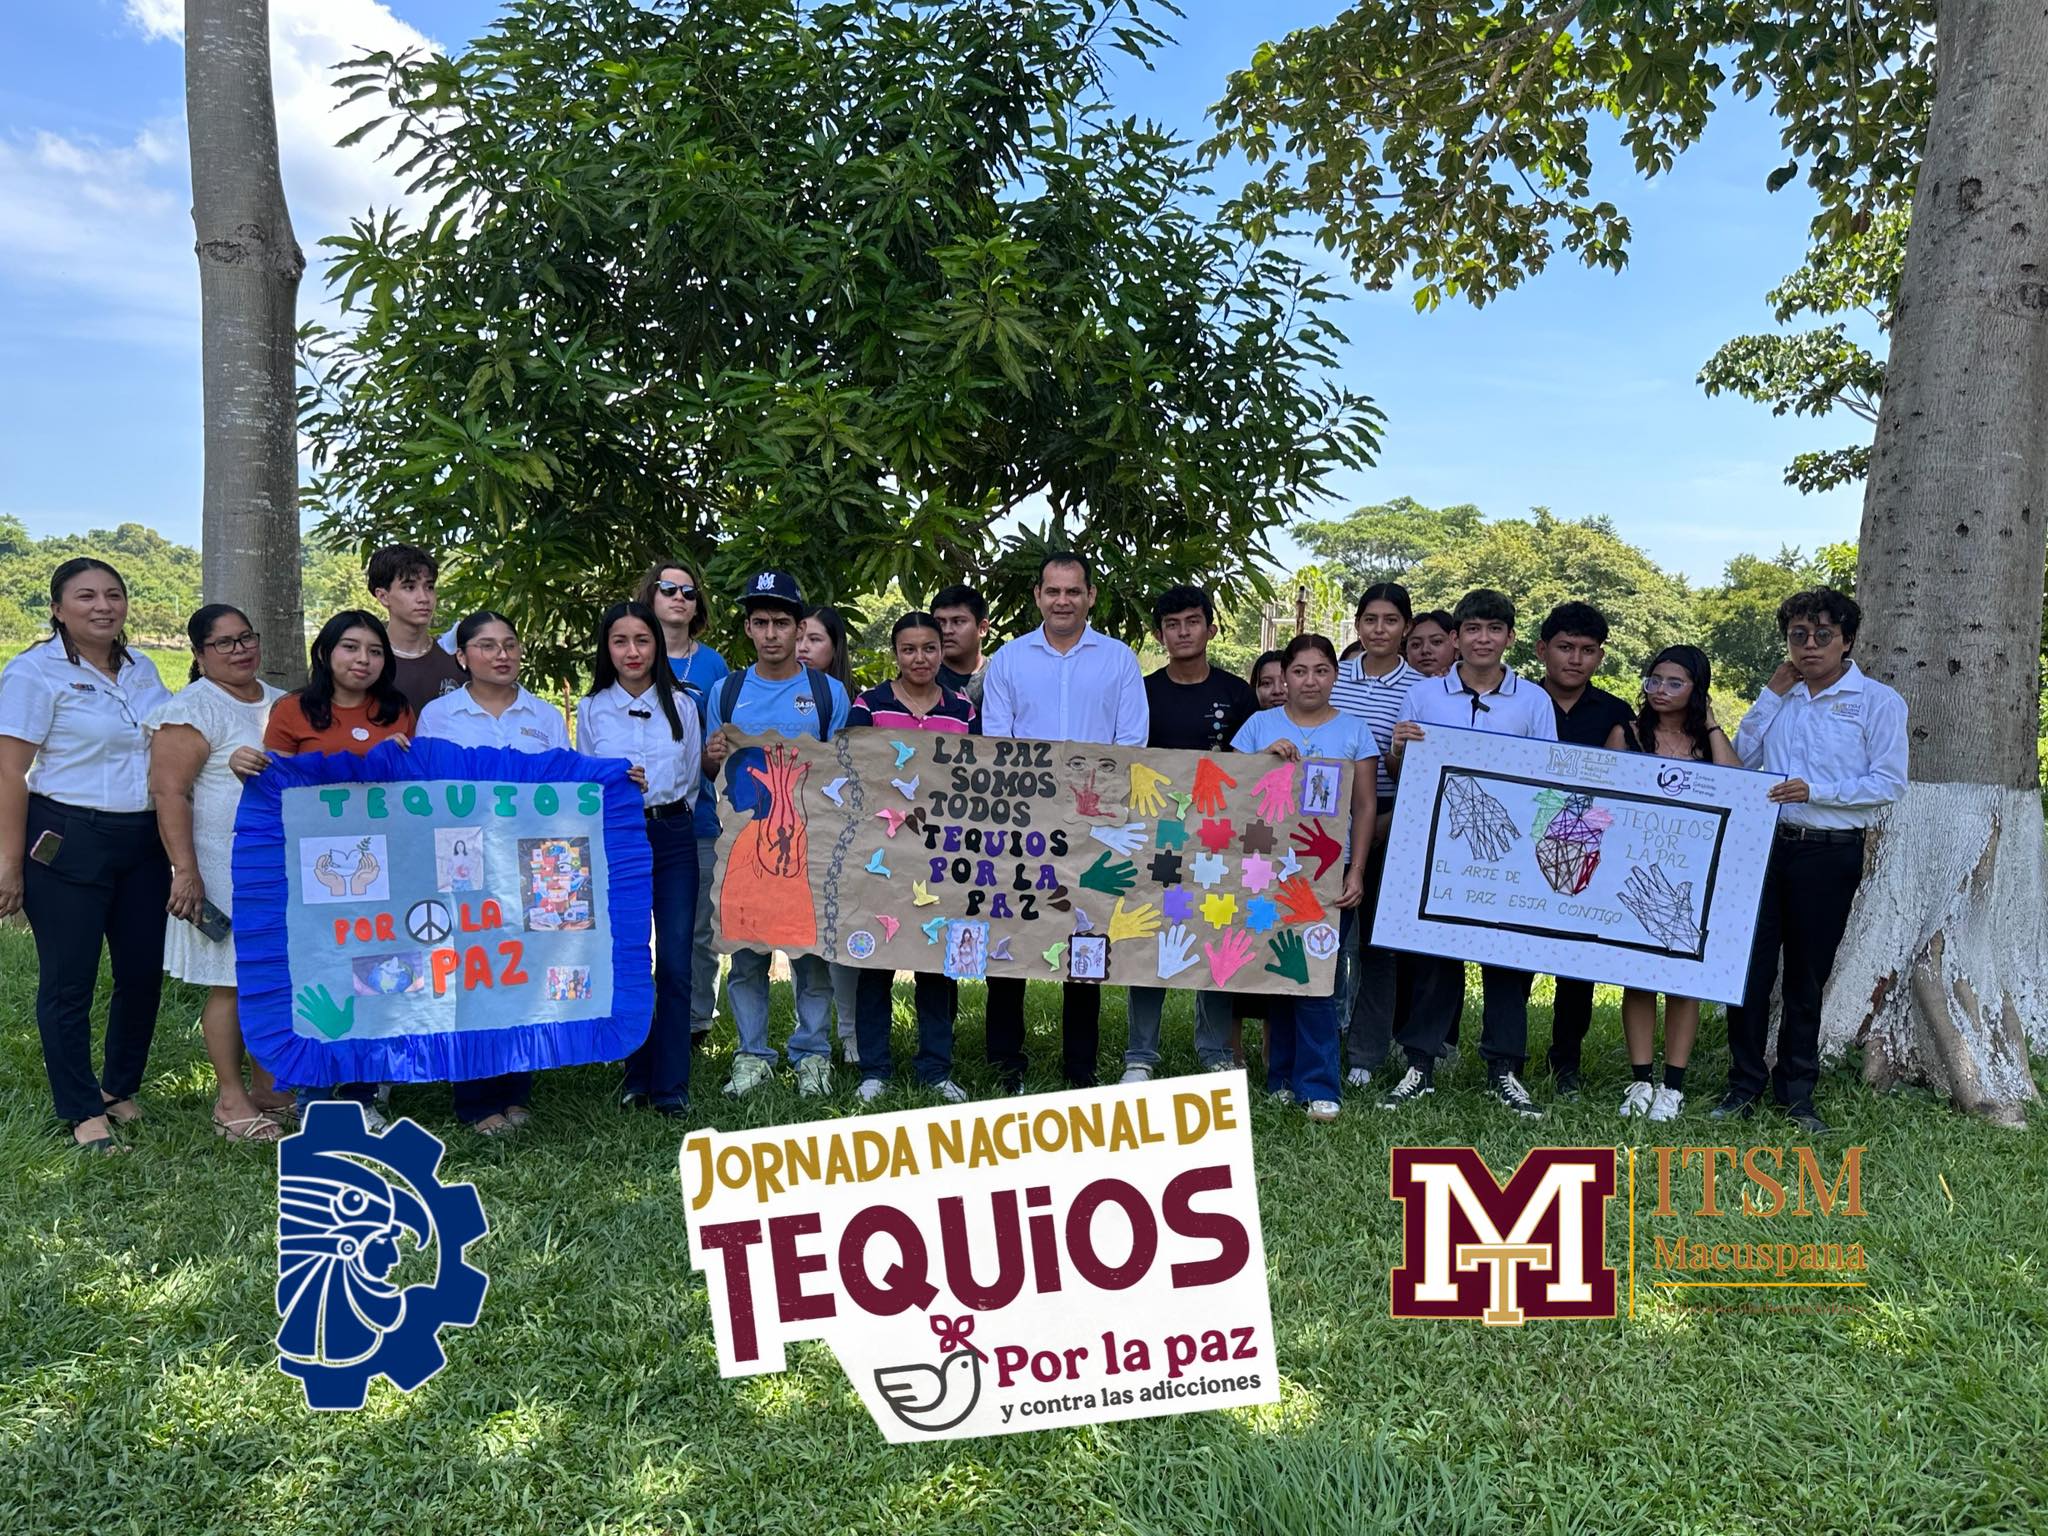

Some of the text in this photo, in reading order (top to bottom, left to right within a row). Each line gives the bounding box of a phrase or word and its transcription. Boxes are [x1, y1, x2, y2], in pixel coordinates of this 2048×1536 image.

[932, 737, 1053, 768] LA PAZ
[951, 766, 1056, 798] SOMOS
[319, 783, 602, 818] TEQUIOS
[928, 791, 1031, 827] TODOS
[1616, 807, 1715, 840] TEQUIOS
[1642, 830, 1679, 850] POR
[922, 824, 1069, 857] TEQUIOS
[1625, 844, 1690, 869] LA PAZ
[930, 856, 1060, 891] POR LA
[1435, 859, 1520, 884] EL ARTE DE
[966, 892, 1039, 920] PAZ
[1433, 885, 1622, 925] LA PAZ ESTA CONTIGO
[334, 899, 502, 945] POR LA
[430, 940, 529, 997] PAZ
